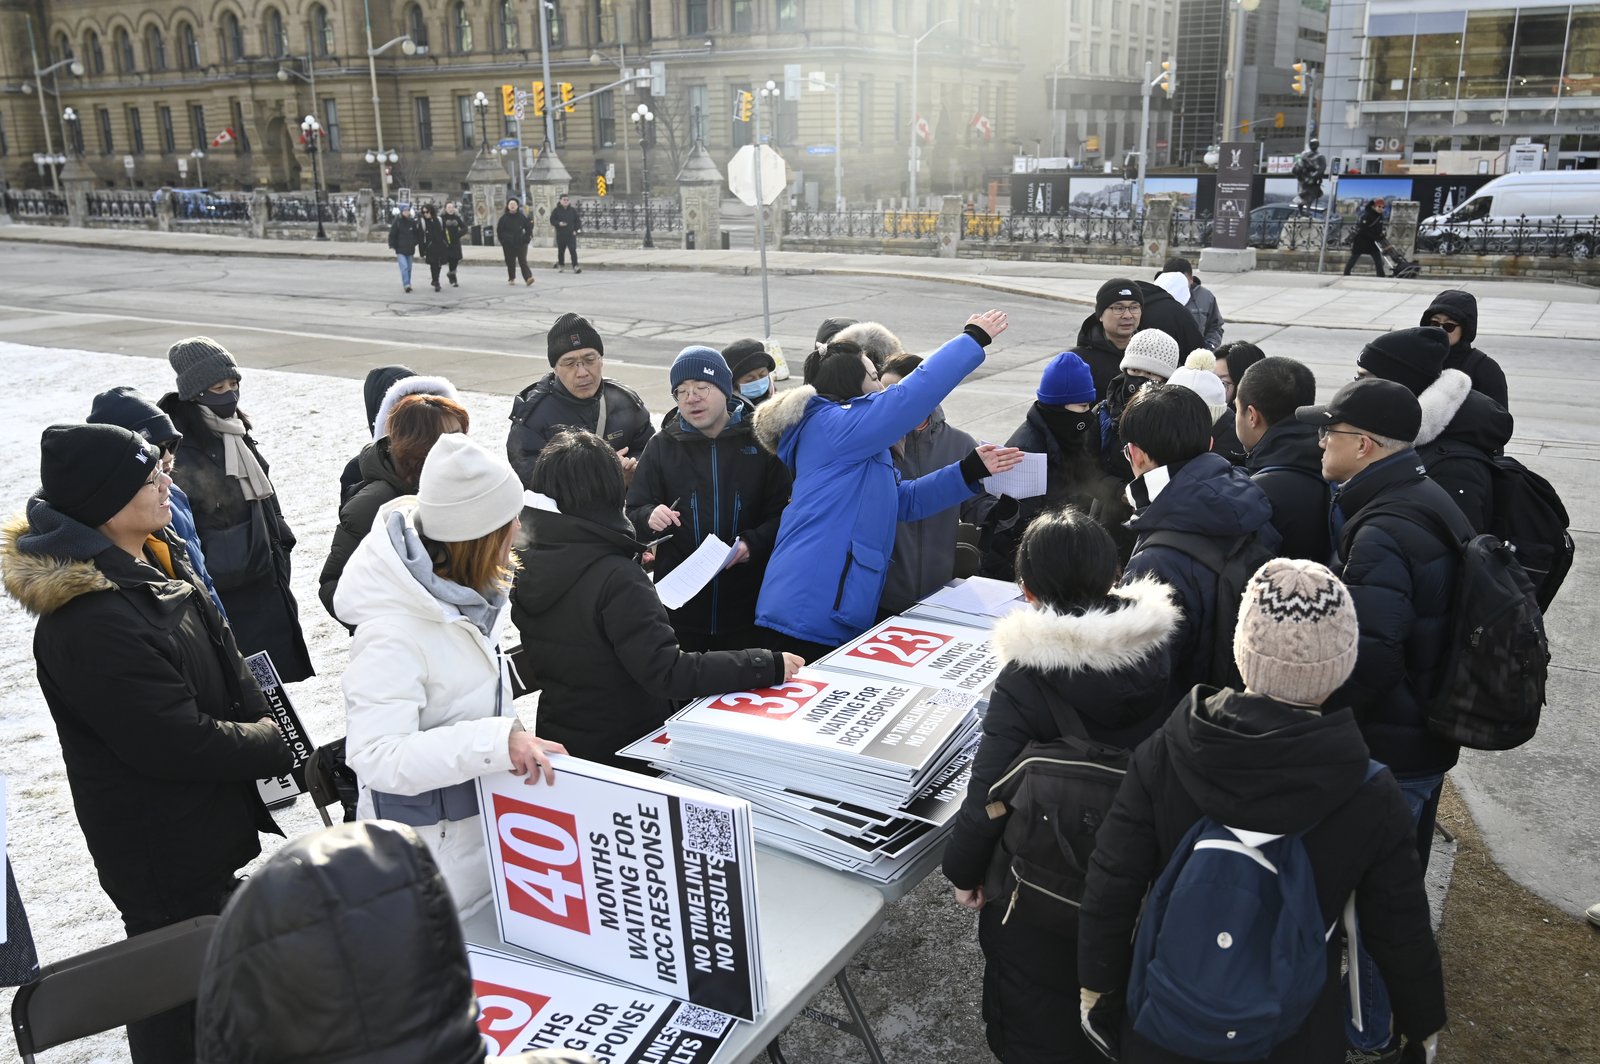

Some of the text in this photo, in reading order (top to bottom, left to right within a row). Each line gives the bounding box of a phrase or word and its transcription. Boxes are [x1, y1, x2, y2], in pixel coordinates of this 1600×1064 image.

[1375, 138, 1399, 150] 90
[1433, 186, 1442, 214] ANADA
[857, 630, 943, 664] 23
[928, 641, 973, 669] MONTHS
[940, 652, 985, 680] WAITING
[976, 640, 992, 653] FO
[956, 672, 986, 690] IRCC
[266, 688, 299, 740] RESULTS
[802, 690, 850, 722] MONTHS
[816, 686, 883, 735] WAITING FOR
[836, 686, 910, 747] IRCC RESPONSE
[881, 700, 933, 746] NO TIMELINE
[905, 705, 952, 747] NO RESULTS
[294, 742, 310, 760] NO
[934, 765, 973, 803] NO RESU
[497, 812, 584, 918] 40
[589, 831, 620, 931] MONTHS
[612, 812, 649, 960] WAITING FOR
[637, 803, 678, 985] IRCC RESPONSE
[682, 840, 712, 973] NO TIMELINE
[706, 853, 735, 972] NO RESULTS
[575, 1003, 619, 1036] FOR
[637, 1026, 682, 1064] LINES
